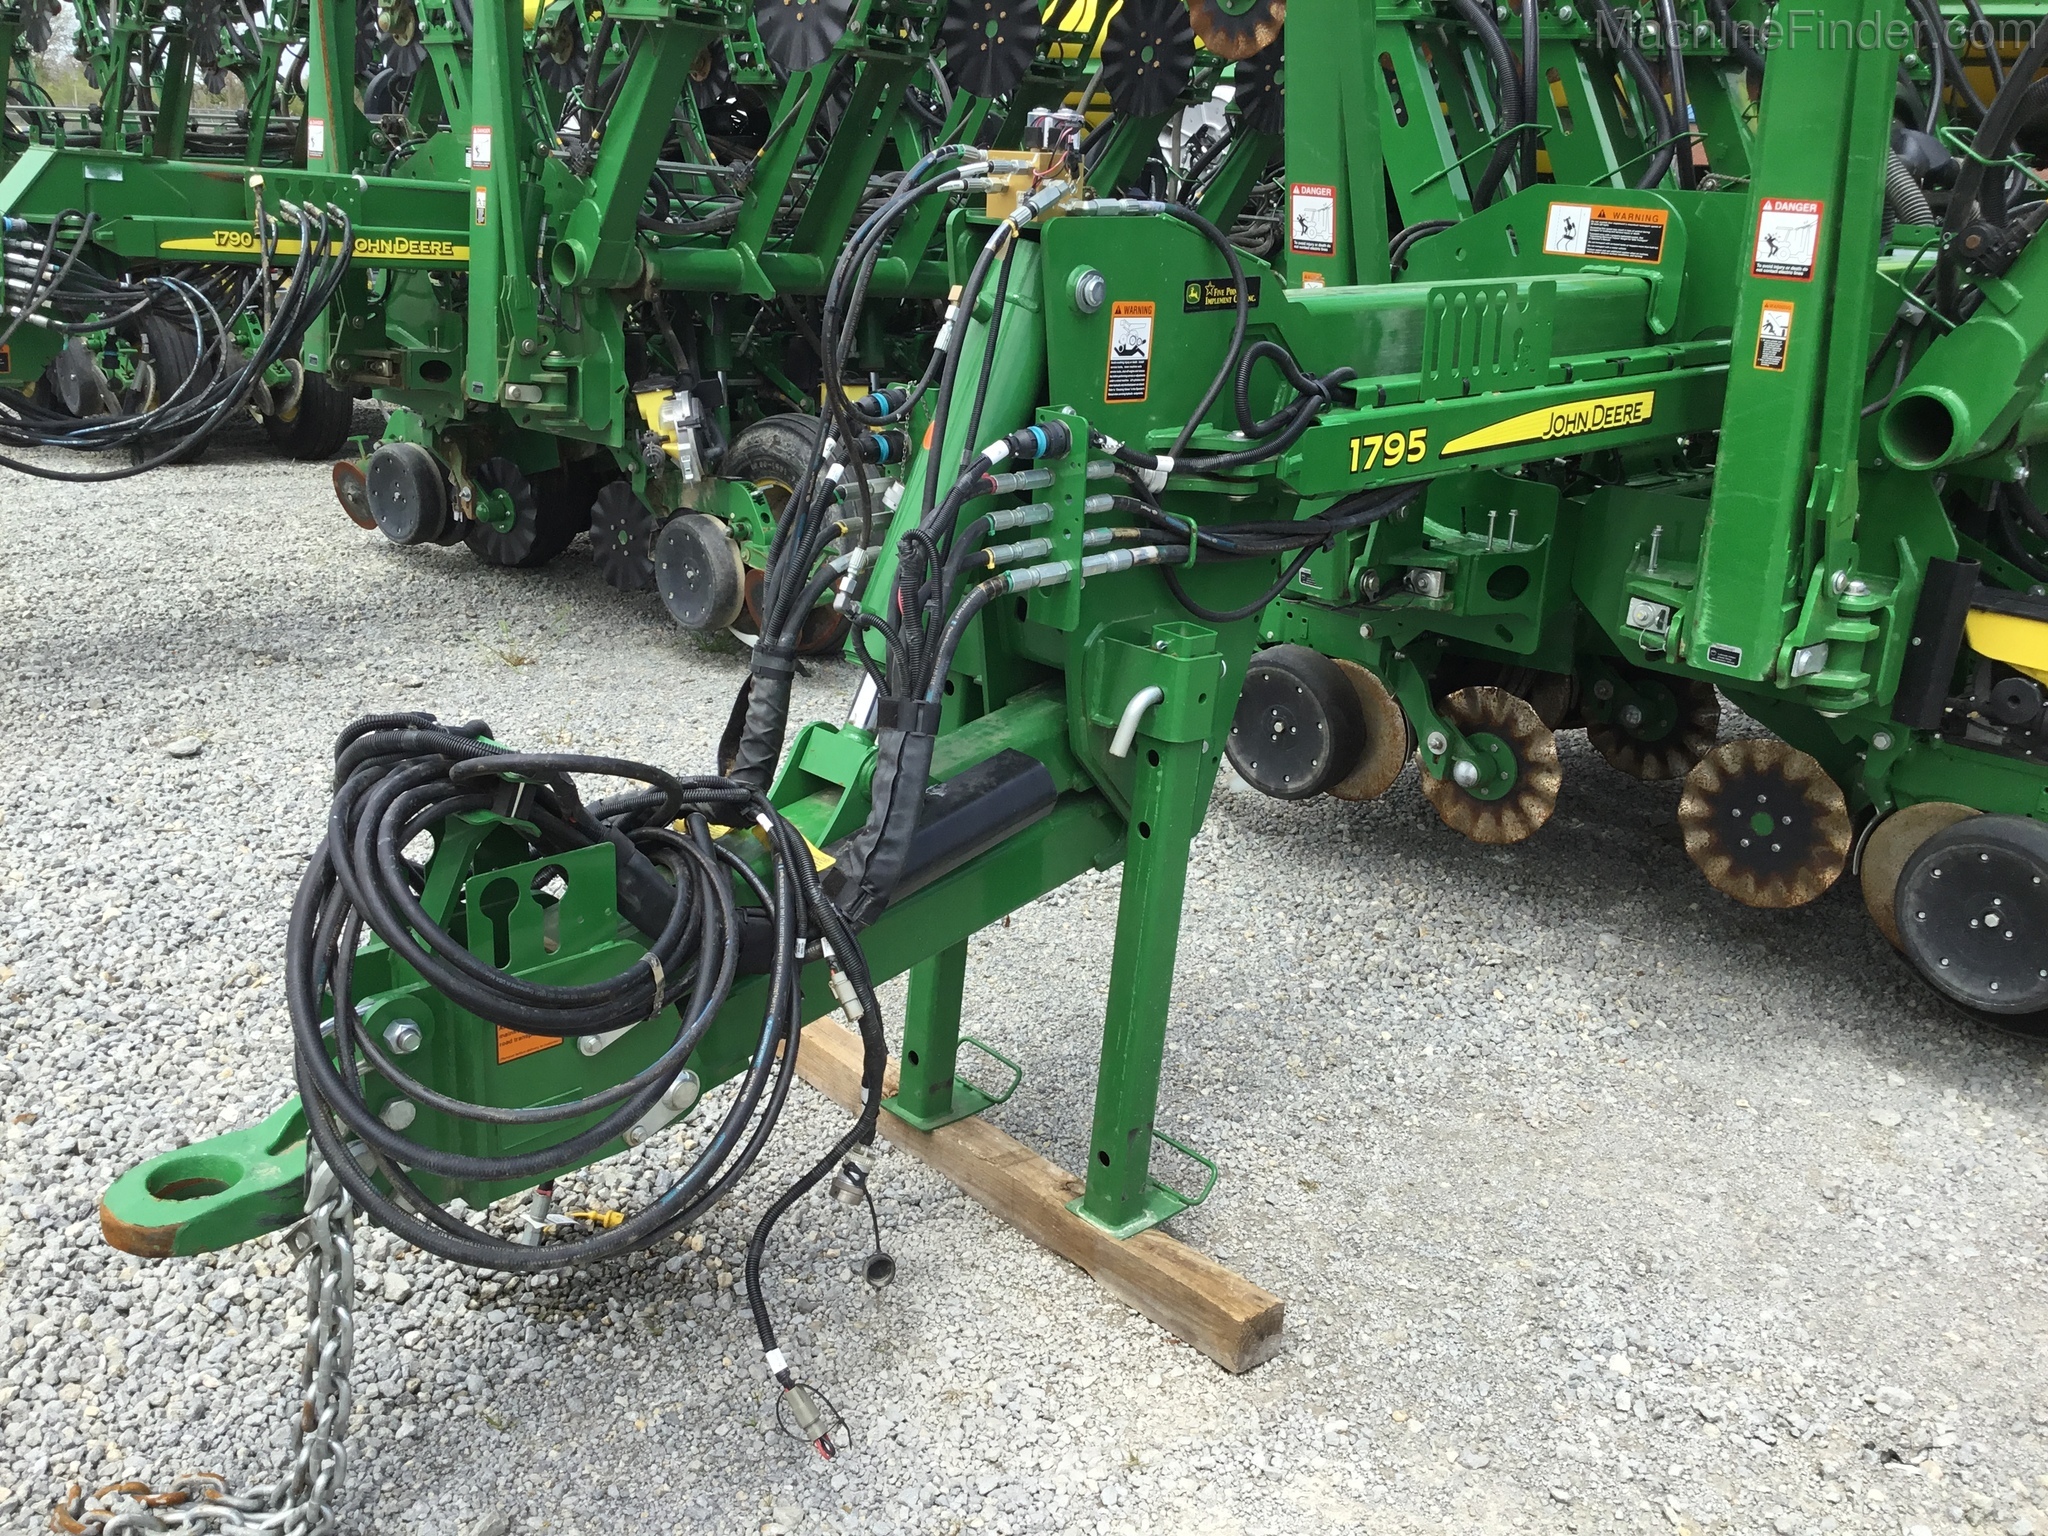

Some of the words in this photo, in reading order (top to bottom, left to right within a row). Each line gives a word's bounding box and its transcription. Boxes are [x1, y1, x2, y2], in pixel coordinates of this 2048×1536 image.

[1301, 185, 1332, 197] DANGER
[1774, 201, 1818, 213] DANGER
[1612, 211, 1660, 223] WARNING
[212, 230, 253, 247] 1790
[354, 238, 393, 253] OHN
[395, 237, 454, 255] DEERE
[1123, 305, 1153, 315] WARNING
[1543, 410, 1590, 438] JOHN
[1591, 401, 1643, 430] DEERE
[1350, 427, 1428, 473] 1795
